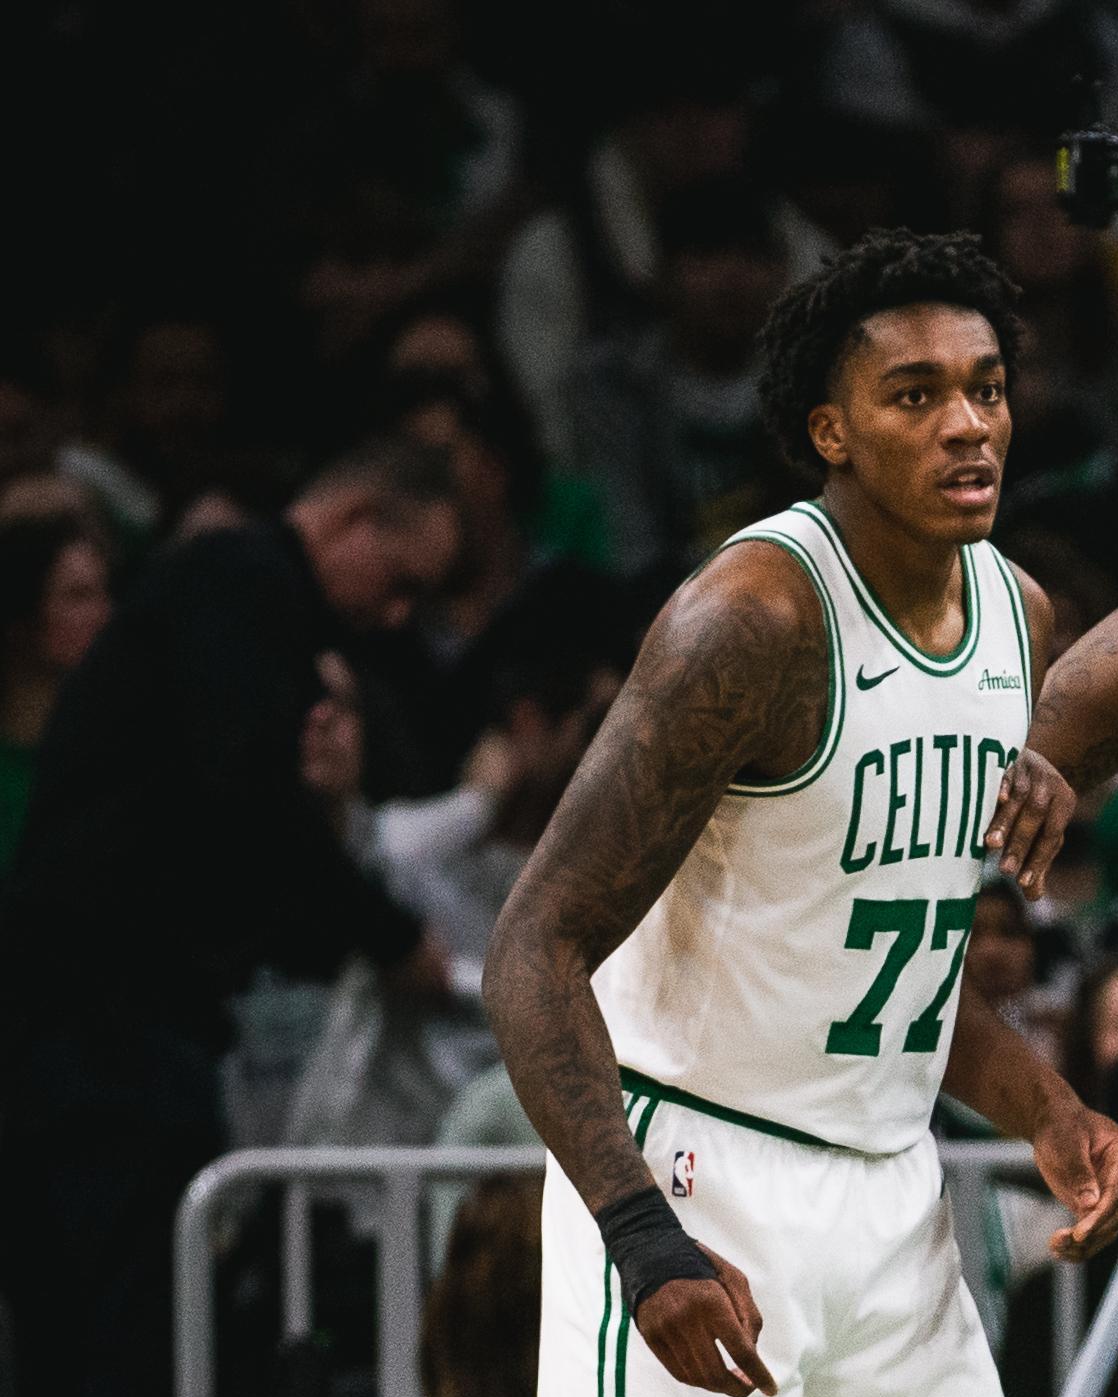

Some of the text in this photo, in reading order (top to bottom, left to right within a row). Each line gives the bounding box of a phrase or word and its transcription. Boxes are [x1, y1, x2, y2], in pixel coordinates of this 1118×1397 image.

[978, 668, 1021, 690] Amica
[840, 734, 1019, 874] CELTIC
[825, 893, 978, 1057] 77
